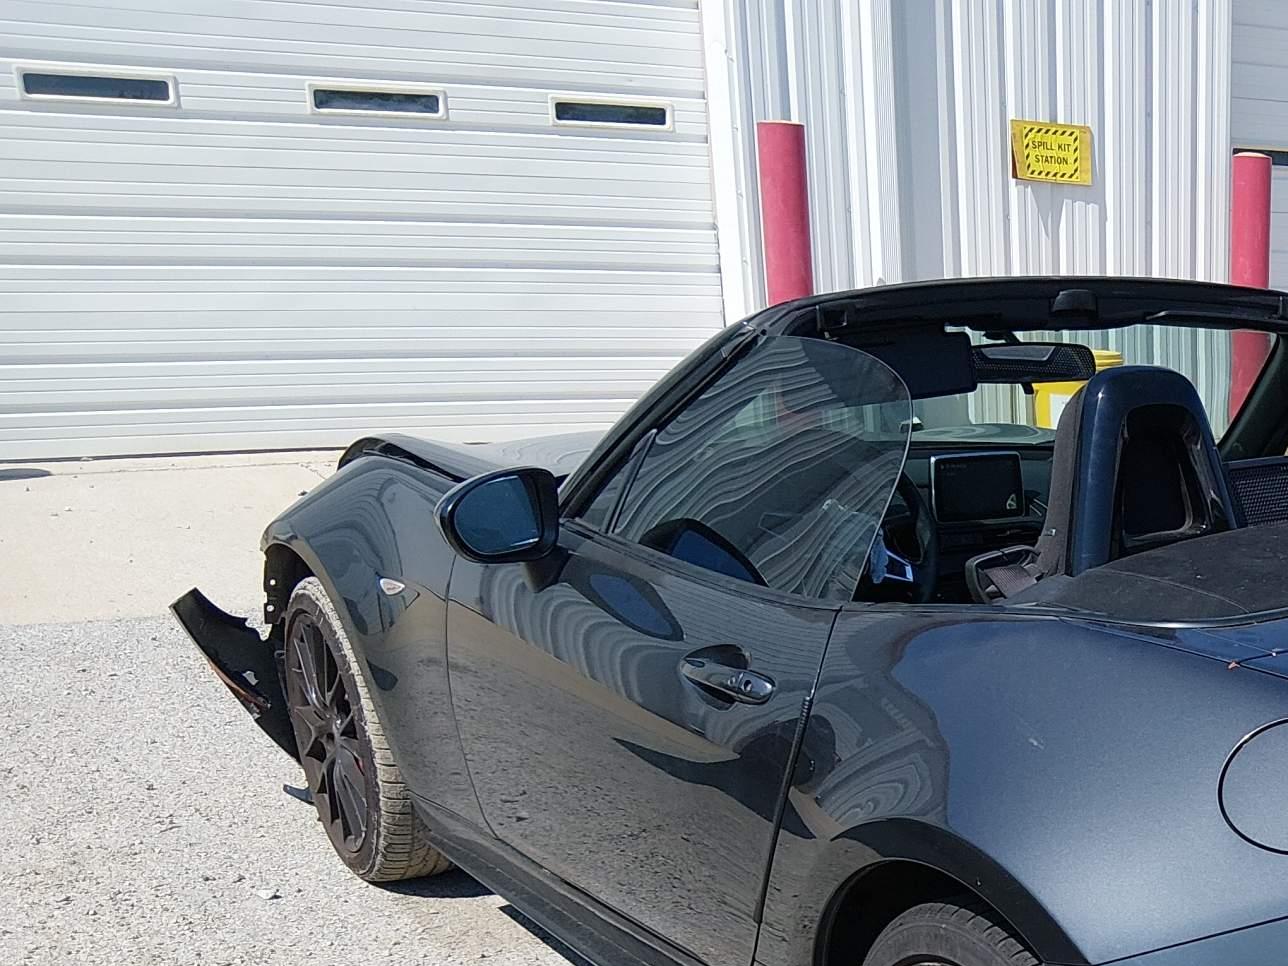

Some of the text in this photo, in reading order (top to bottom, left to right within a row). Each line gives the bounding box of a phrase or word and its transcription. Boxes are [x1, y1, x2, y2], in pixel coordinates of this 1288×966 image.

[1031, 140, 1072, 152] SPILL KIT
[1034, 154, 1069, 165] STATION
